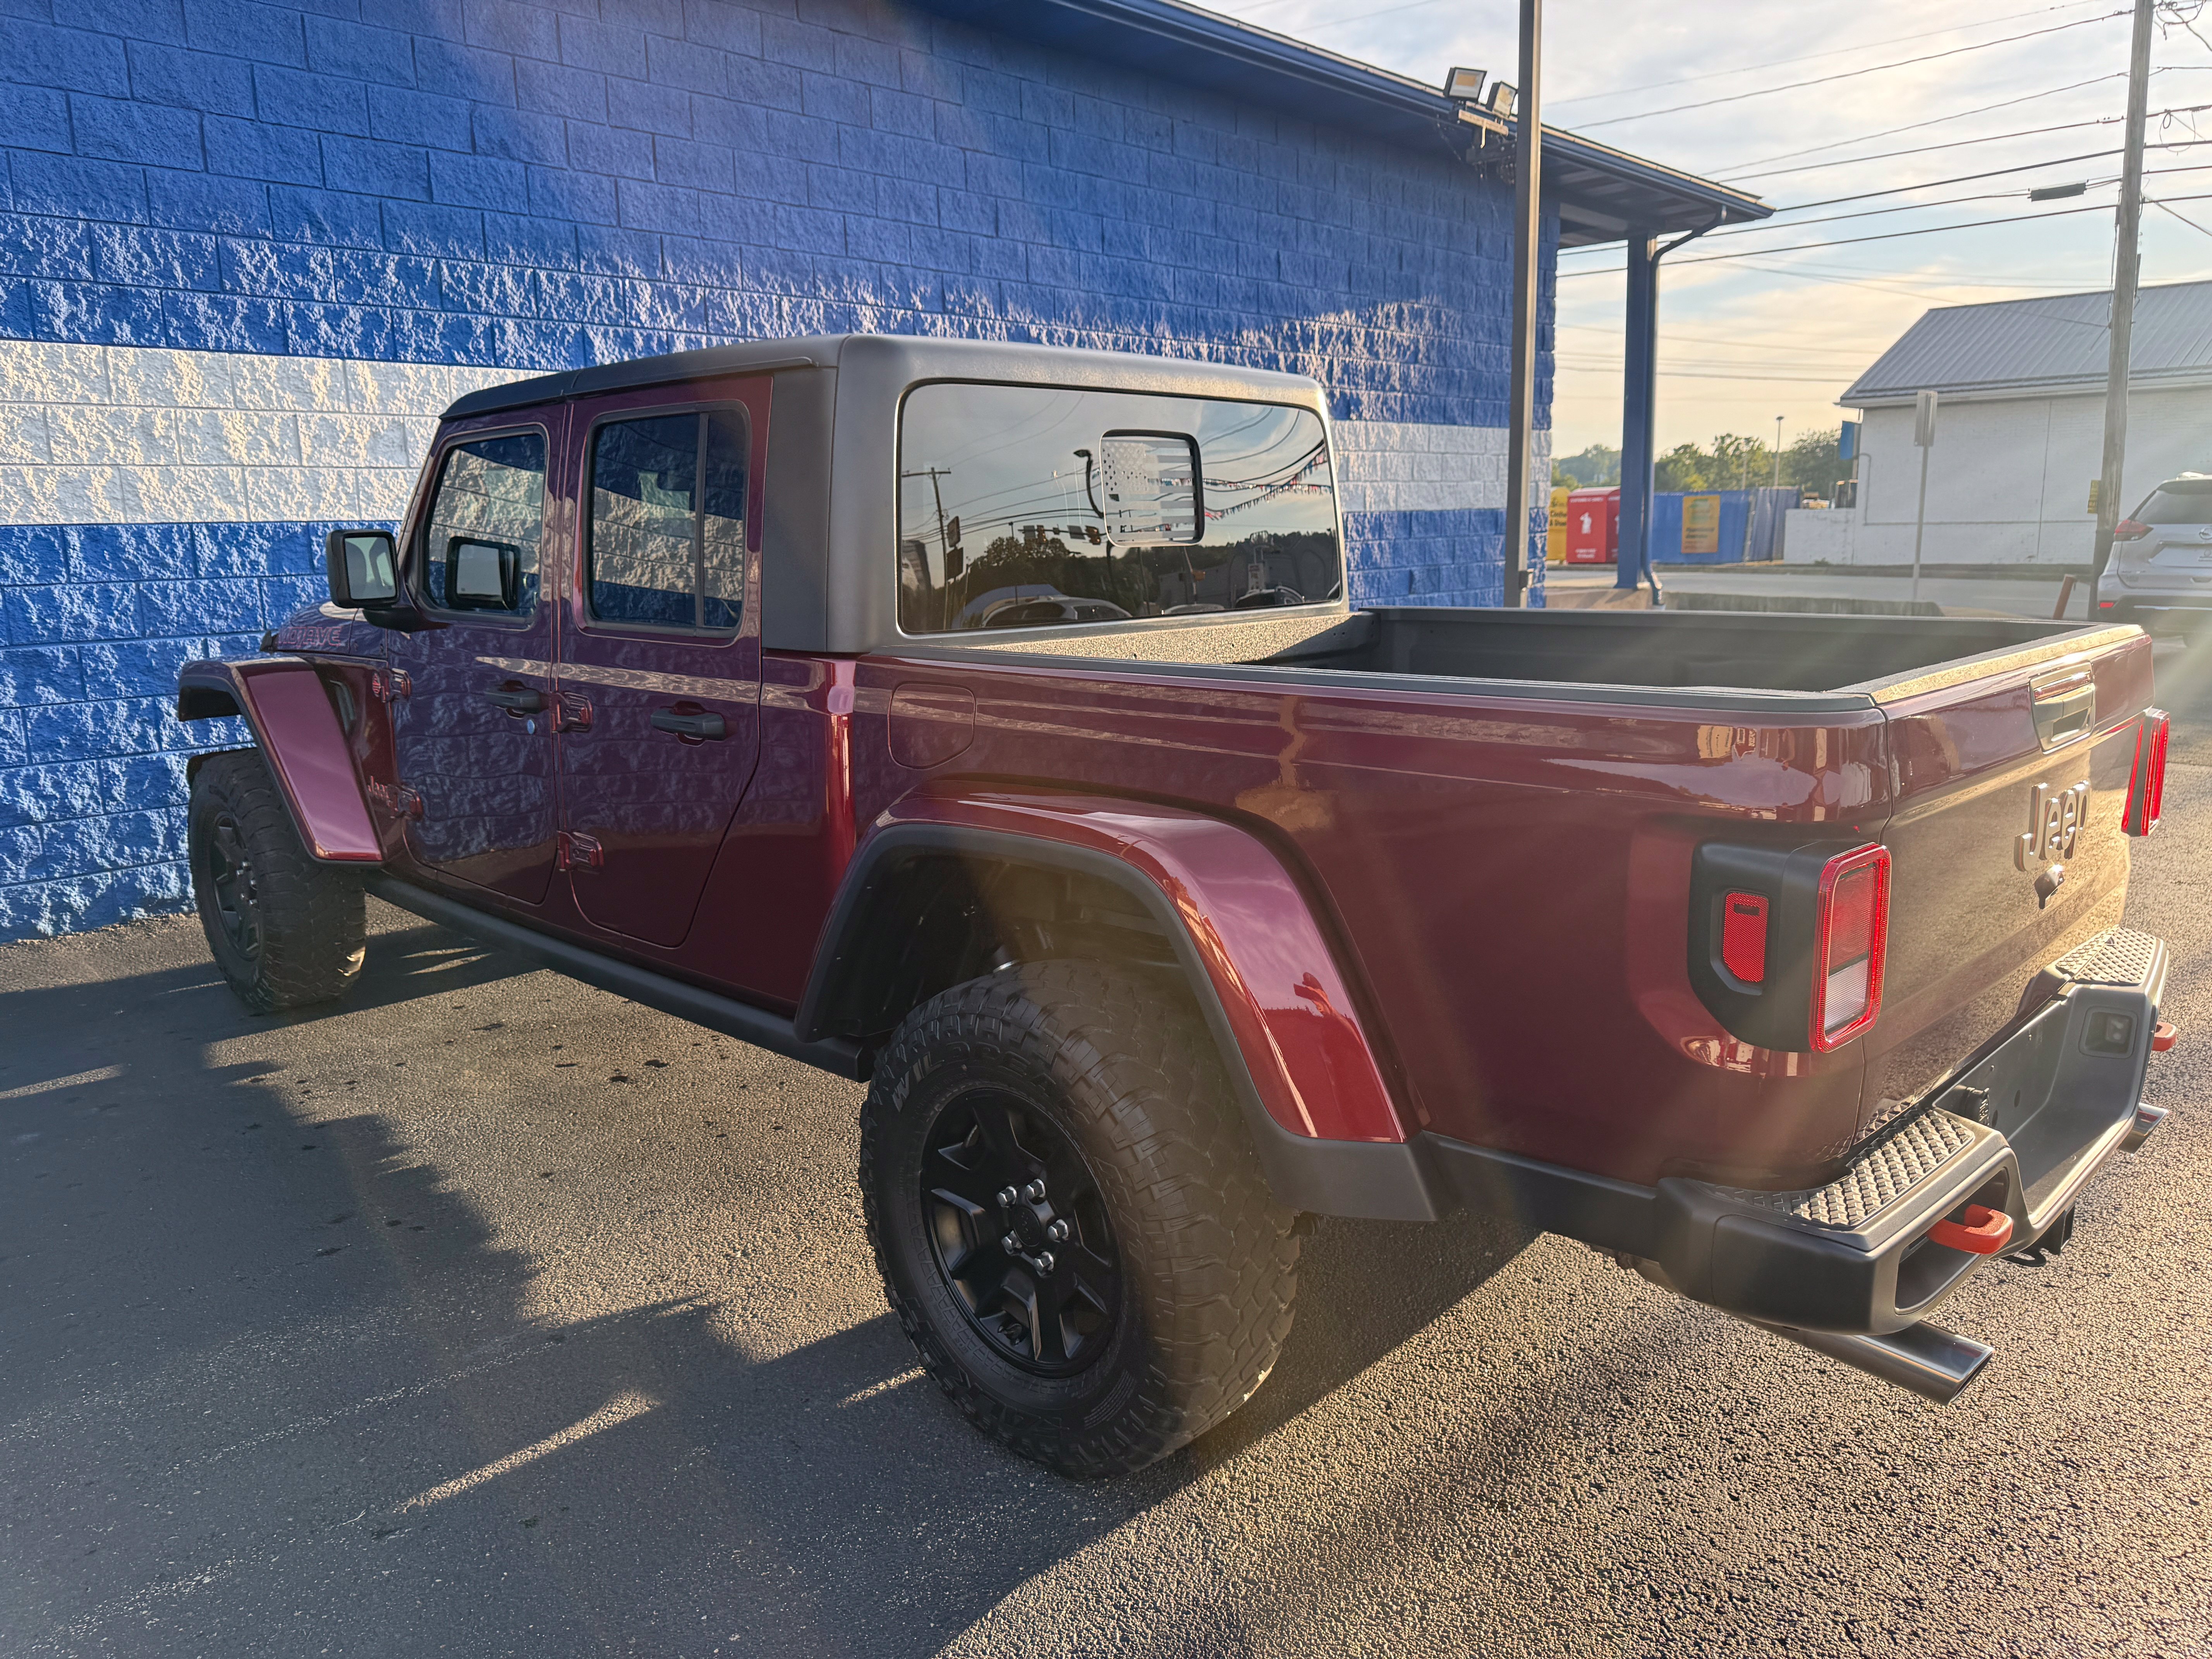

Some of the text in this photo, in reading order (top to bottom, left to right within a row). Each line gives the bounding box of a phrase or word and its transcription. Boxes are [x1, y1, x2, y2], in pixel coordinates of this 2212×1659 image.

[275, 626, 342, 647] MOJAVE
[2014, 780, 2091, 872] Jeep
[891, 1040, 1091, 1128] WILDPEAK
